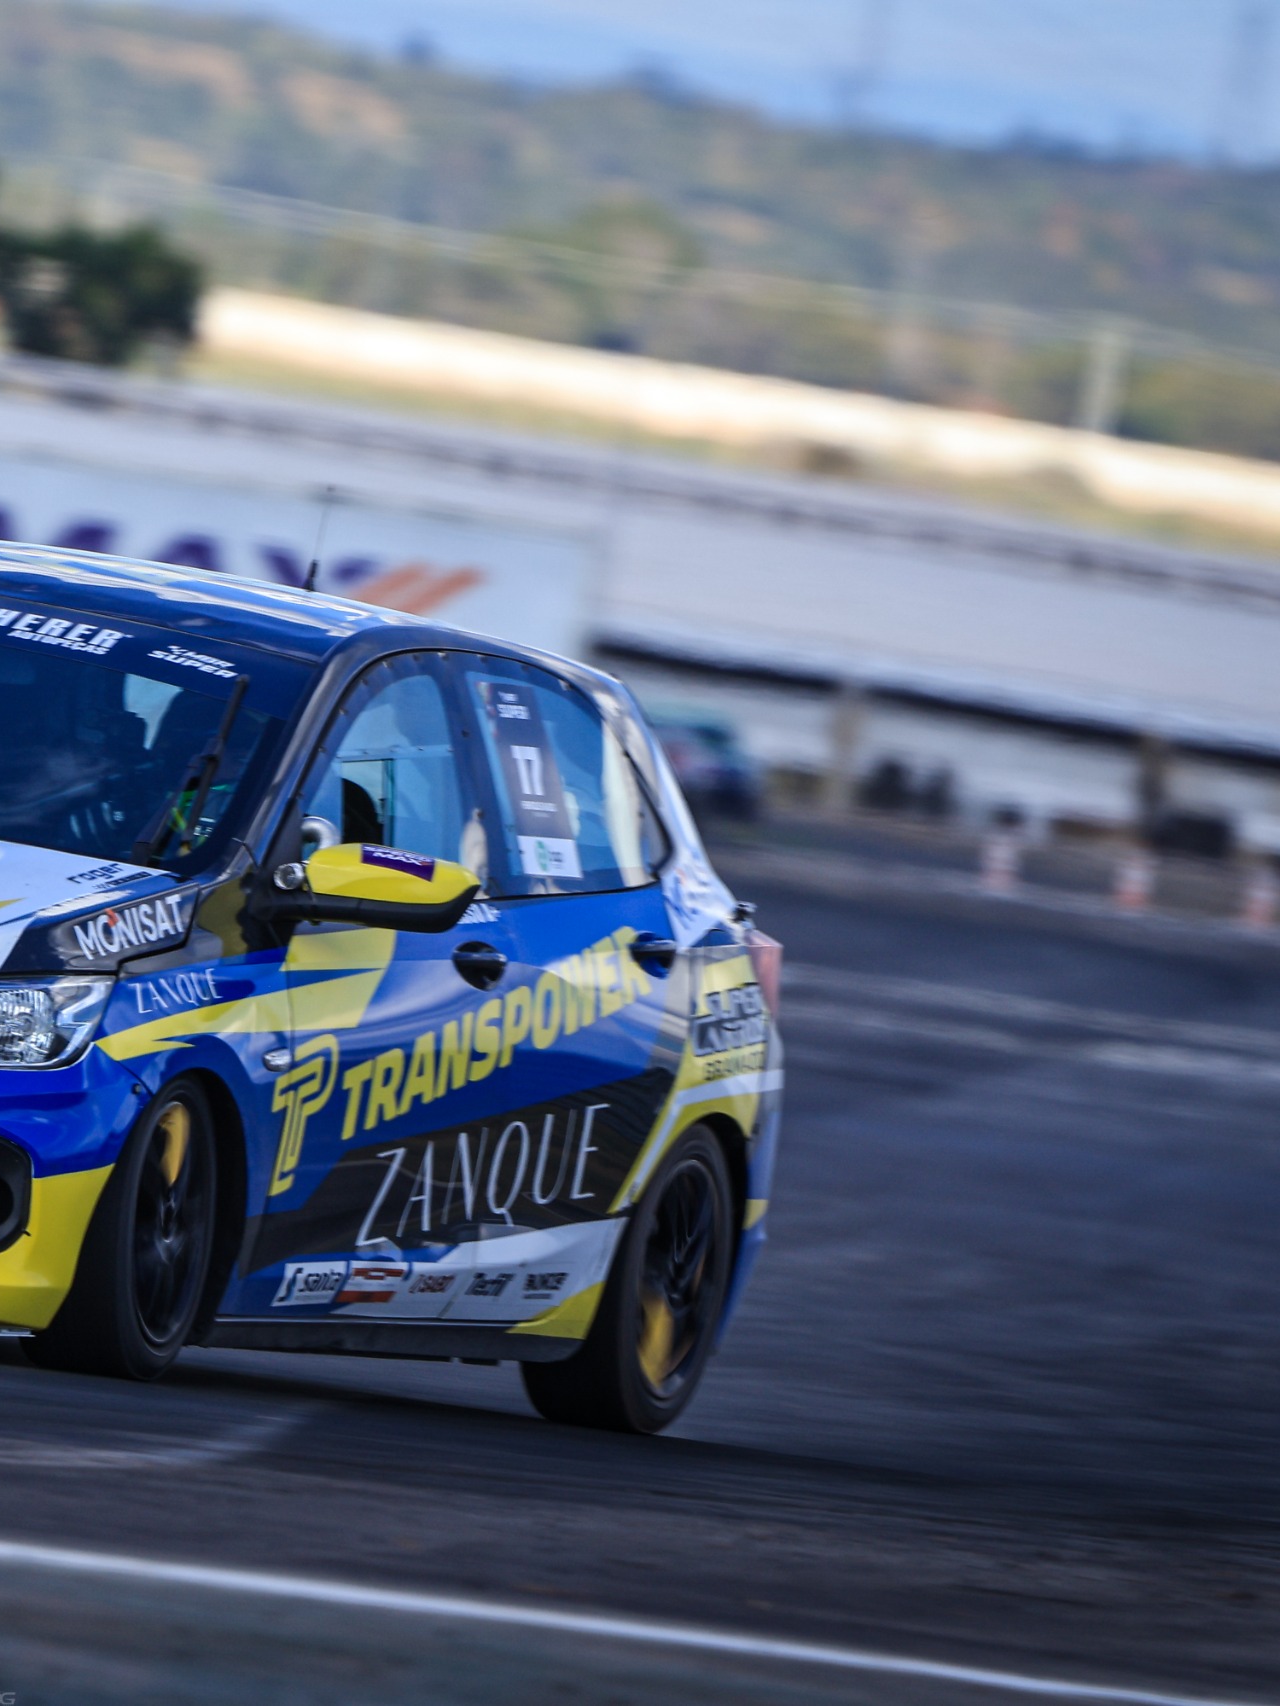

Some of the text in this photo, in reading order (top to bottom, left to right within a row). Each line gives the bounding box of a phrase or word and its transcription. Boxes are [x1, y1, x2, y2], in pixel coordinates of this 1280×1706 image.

[147, 650, 239, 679] SUPER
[66, 863, 124, 884] roger
[74, 894, 184, 960] MONISAT
[128, 968, 224, 1014] ZANQUE
[341, 925, 652, 1140] TRANSPOWER
[354, 1103, 611, 1248] ZANQUE
